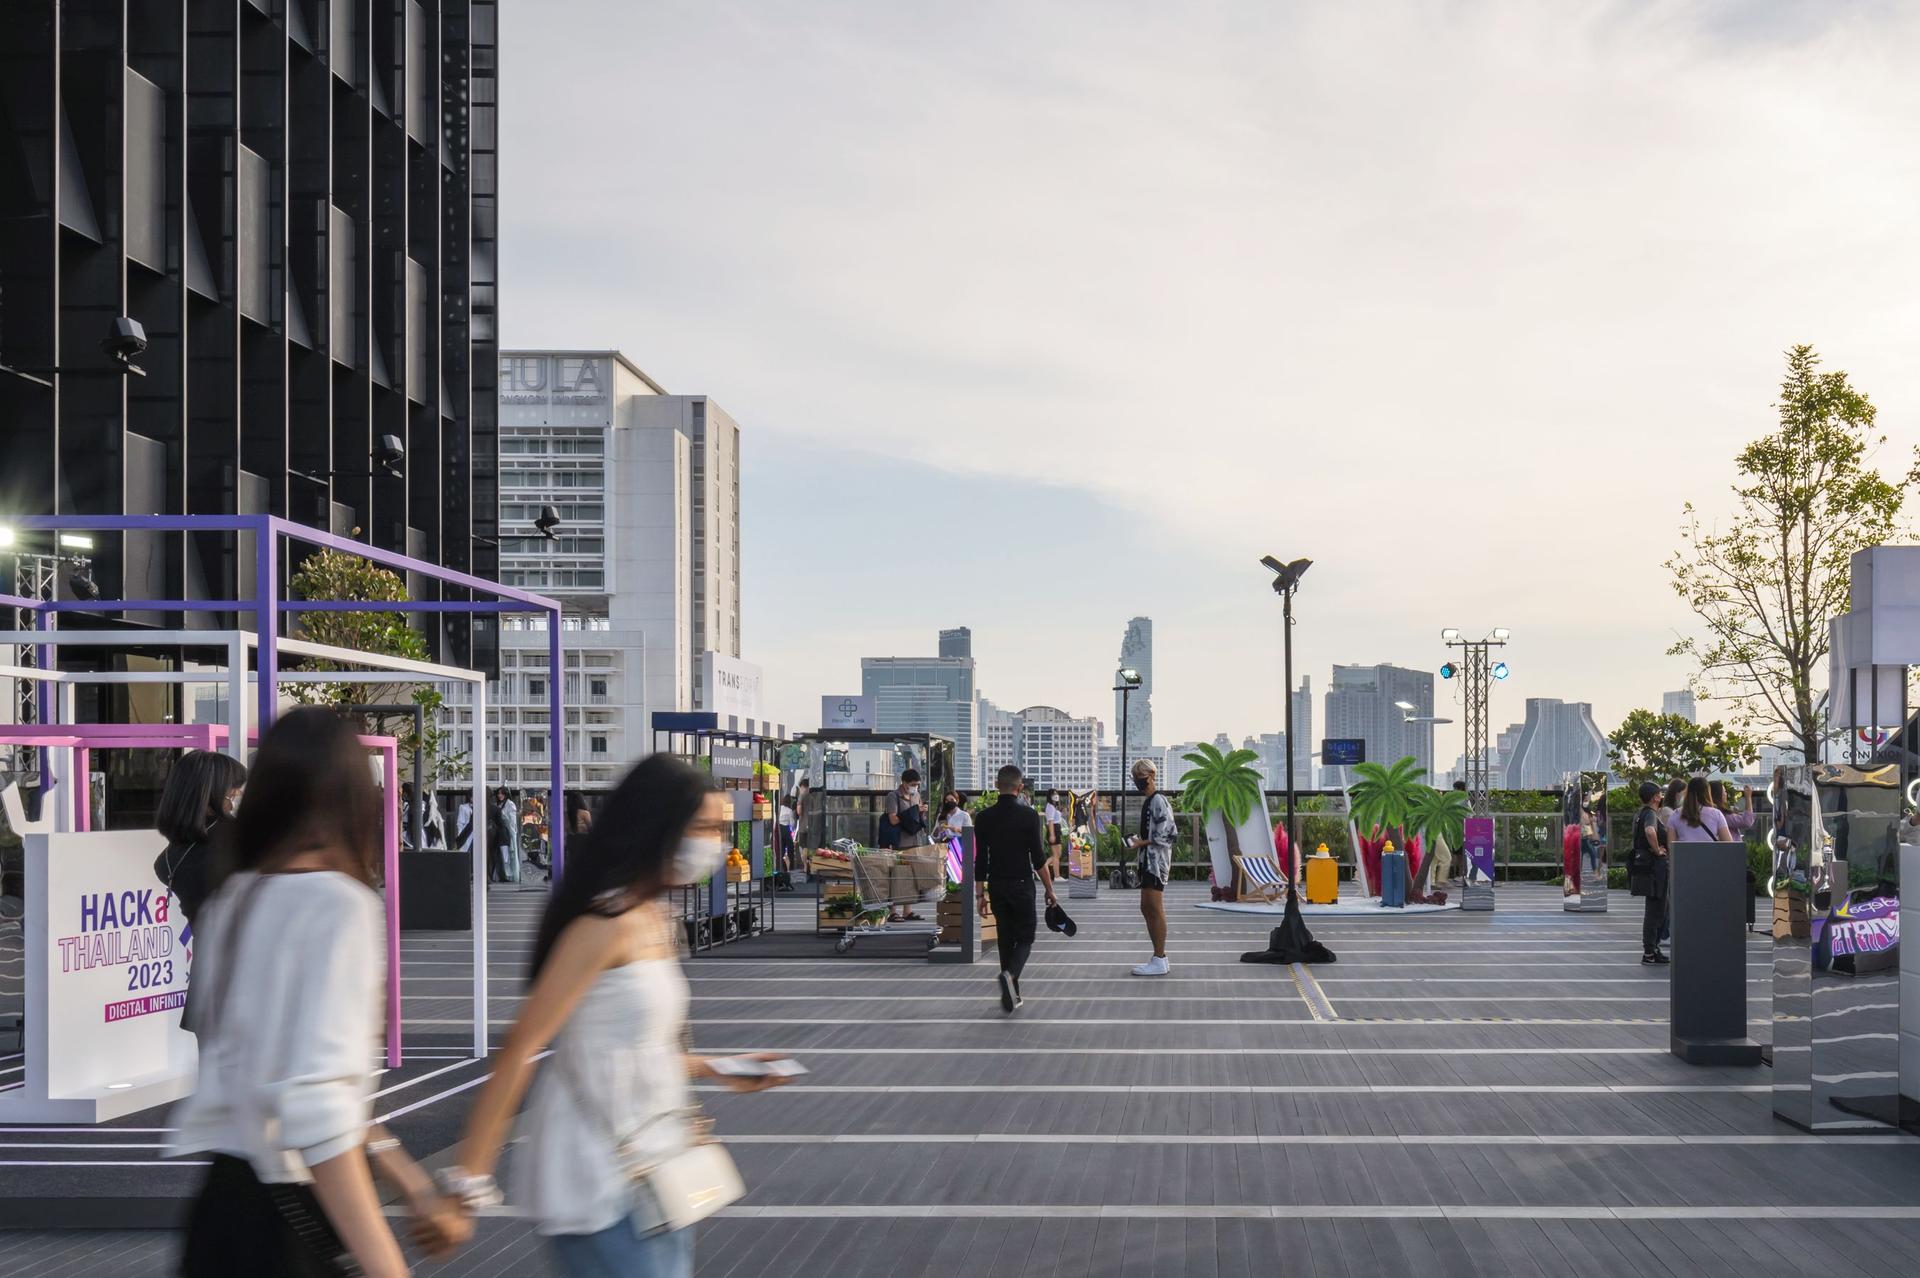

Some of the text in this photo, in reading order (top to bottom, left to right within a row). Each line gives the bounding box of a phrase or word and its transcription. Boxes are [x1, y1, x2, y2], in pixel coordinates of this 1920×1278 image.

[499, 357, 603, 392] HULA
[1842, 750, 1902, 760] CNNXION
[58, 925, 174, 973] THAILAND
[127, 960, 173, 991] 2023
[109, 991, 188, 1020] DIGITAL INFINITY
